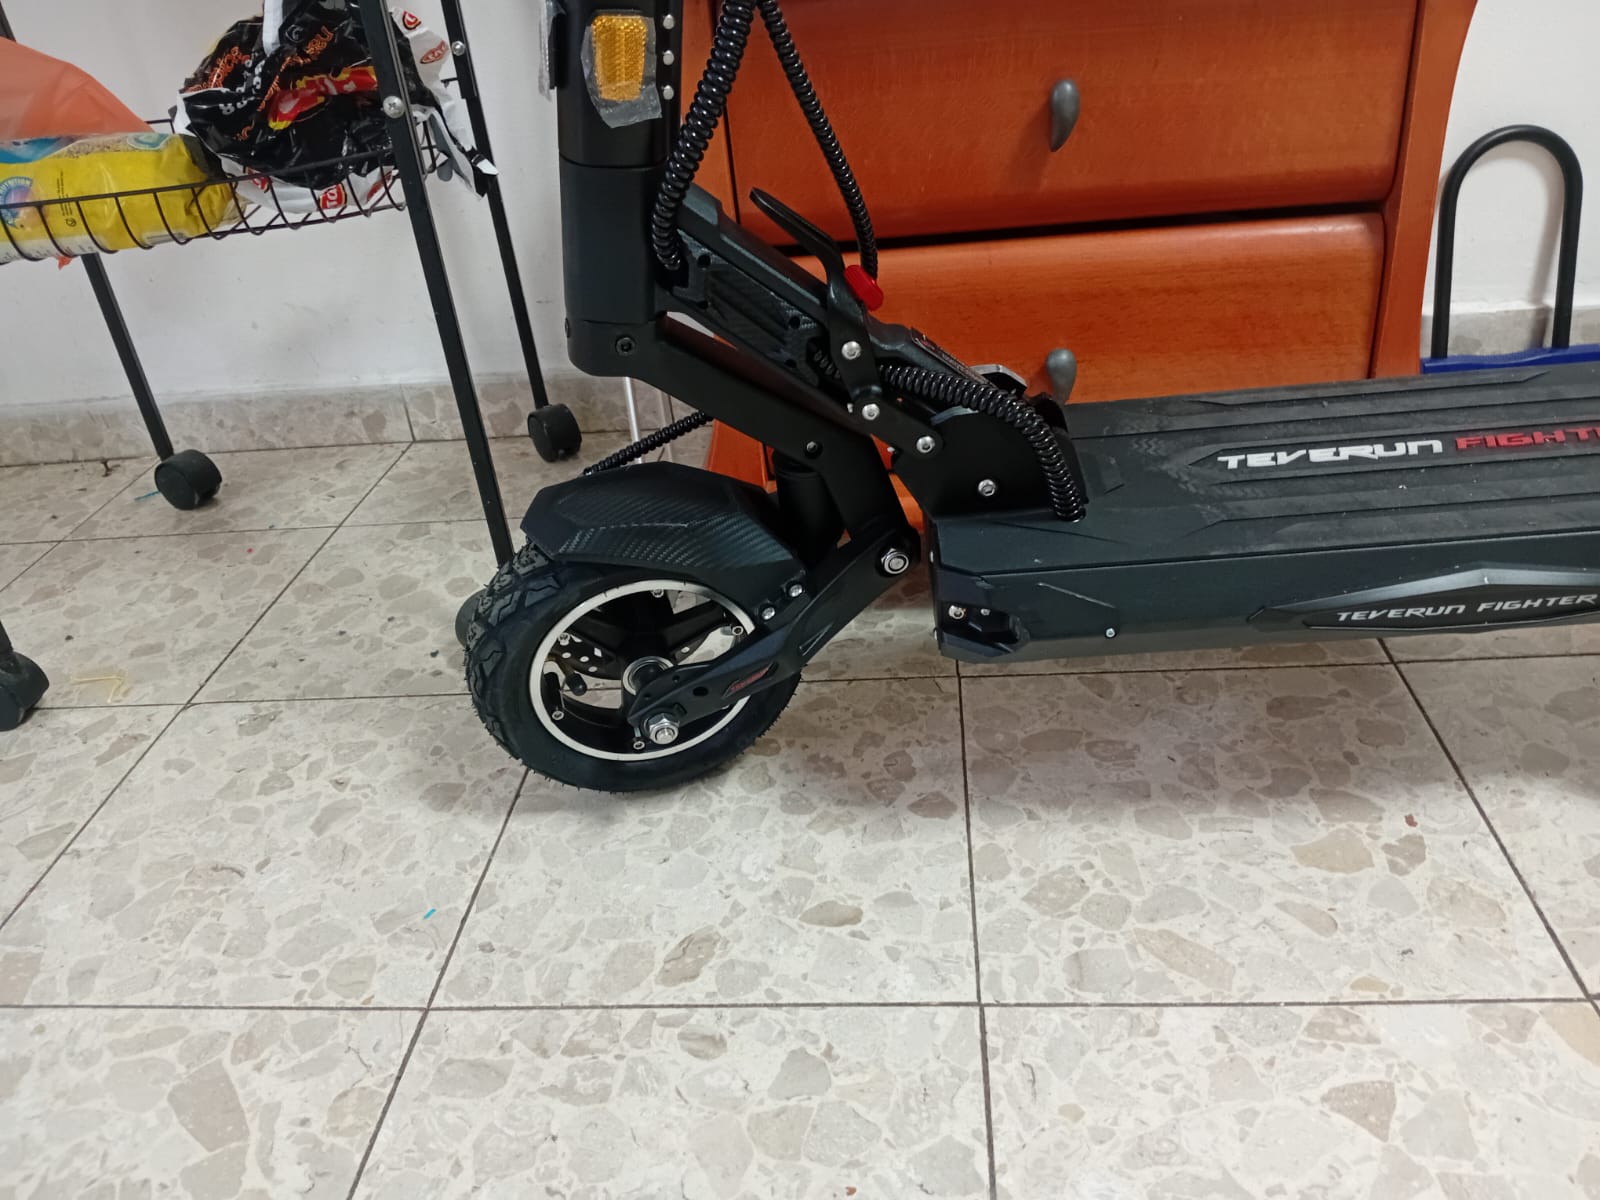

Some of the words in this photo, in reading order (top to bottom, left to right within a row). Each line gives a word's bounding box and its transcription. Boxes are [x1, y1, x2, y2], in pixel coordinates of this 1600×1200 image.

[1217, 439, 1443, 470] TEVERUN
[1456, 426, 1600, 449] FIGHT
[1337, 604, 1466, 622] TEVERUN
[1477, 594, 1599, 612] FIGHTER
